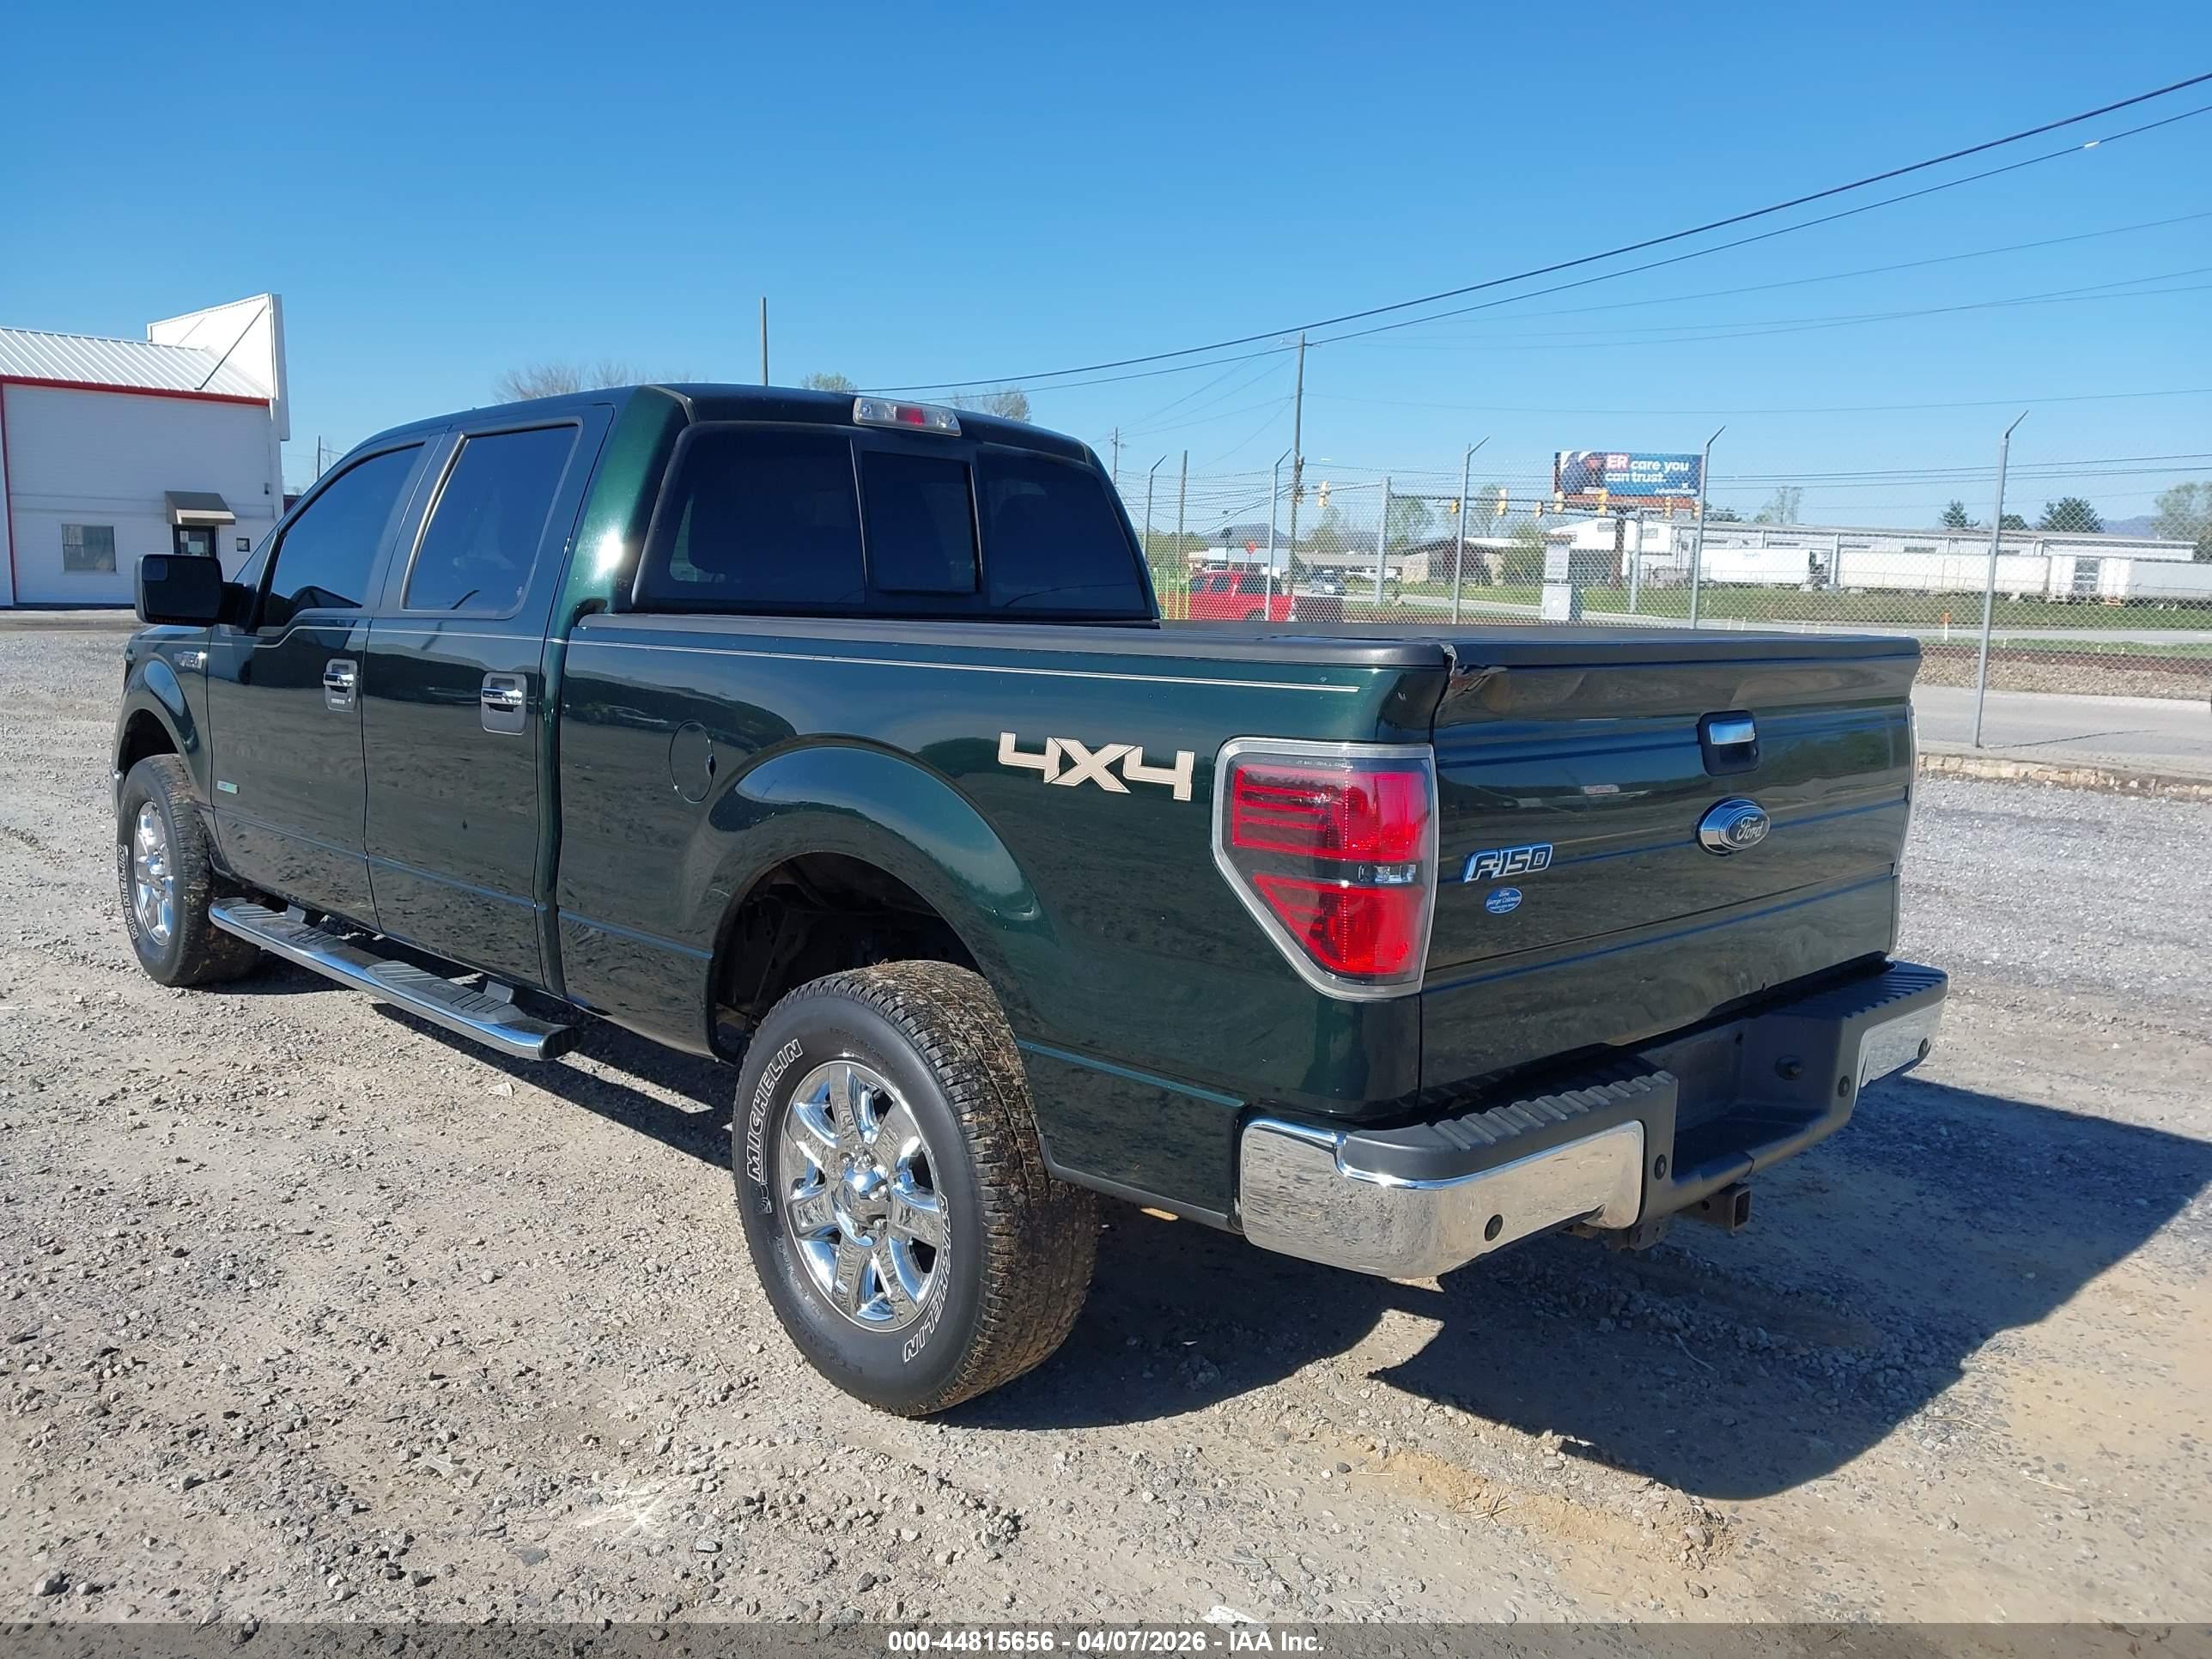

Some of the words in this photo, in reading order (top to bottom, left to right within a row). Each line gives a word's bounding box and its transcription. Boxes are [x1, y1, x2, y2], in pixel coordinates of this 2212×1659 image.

[1605, 472, 1630, 483] can
[1632, 471, 1667, 483] trust.
[1606, 455, 1628, 470] ER
[1631, 459, 1661, 471] care
[1663, 461, 1690, 473] you
[1736, 817, 1765, 841] Ford
[1463, 842, 1553, 883] F-150
[117, 845, 139, 940] MICHELIN
[746, 1038, 805, 1182] MICHELIN
[903, 1194, 951, 1363] MICHELIN
